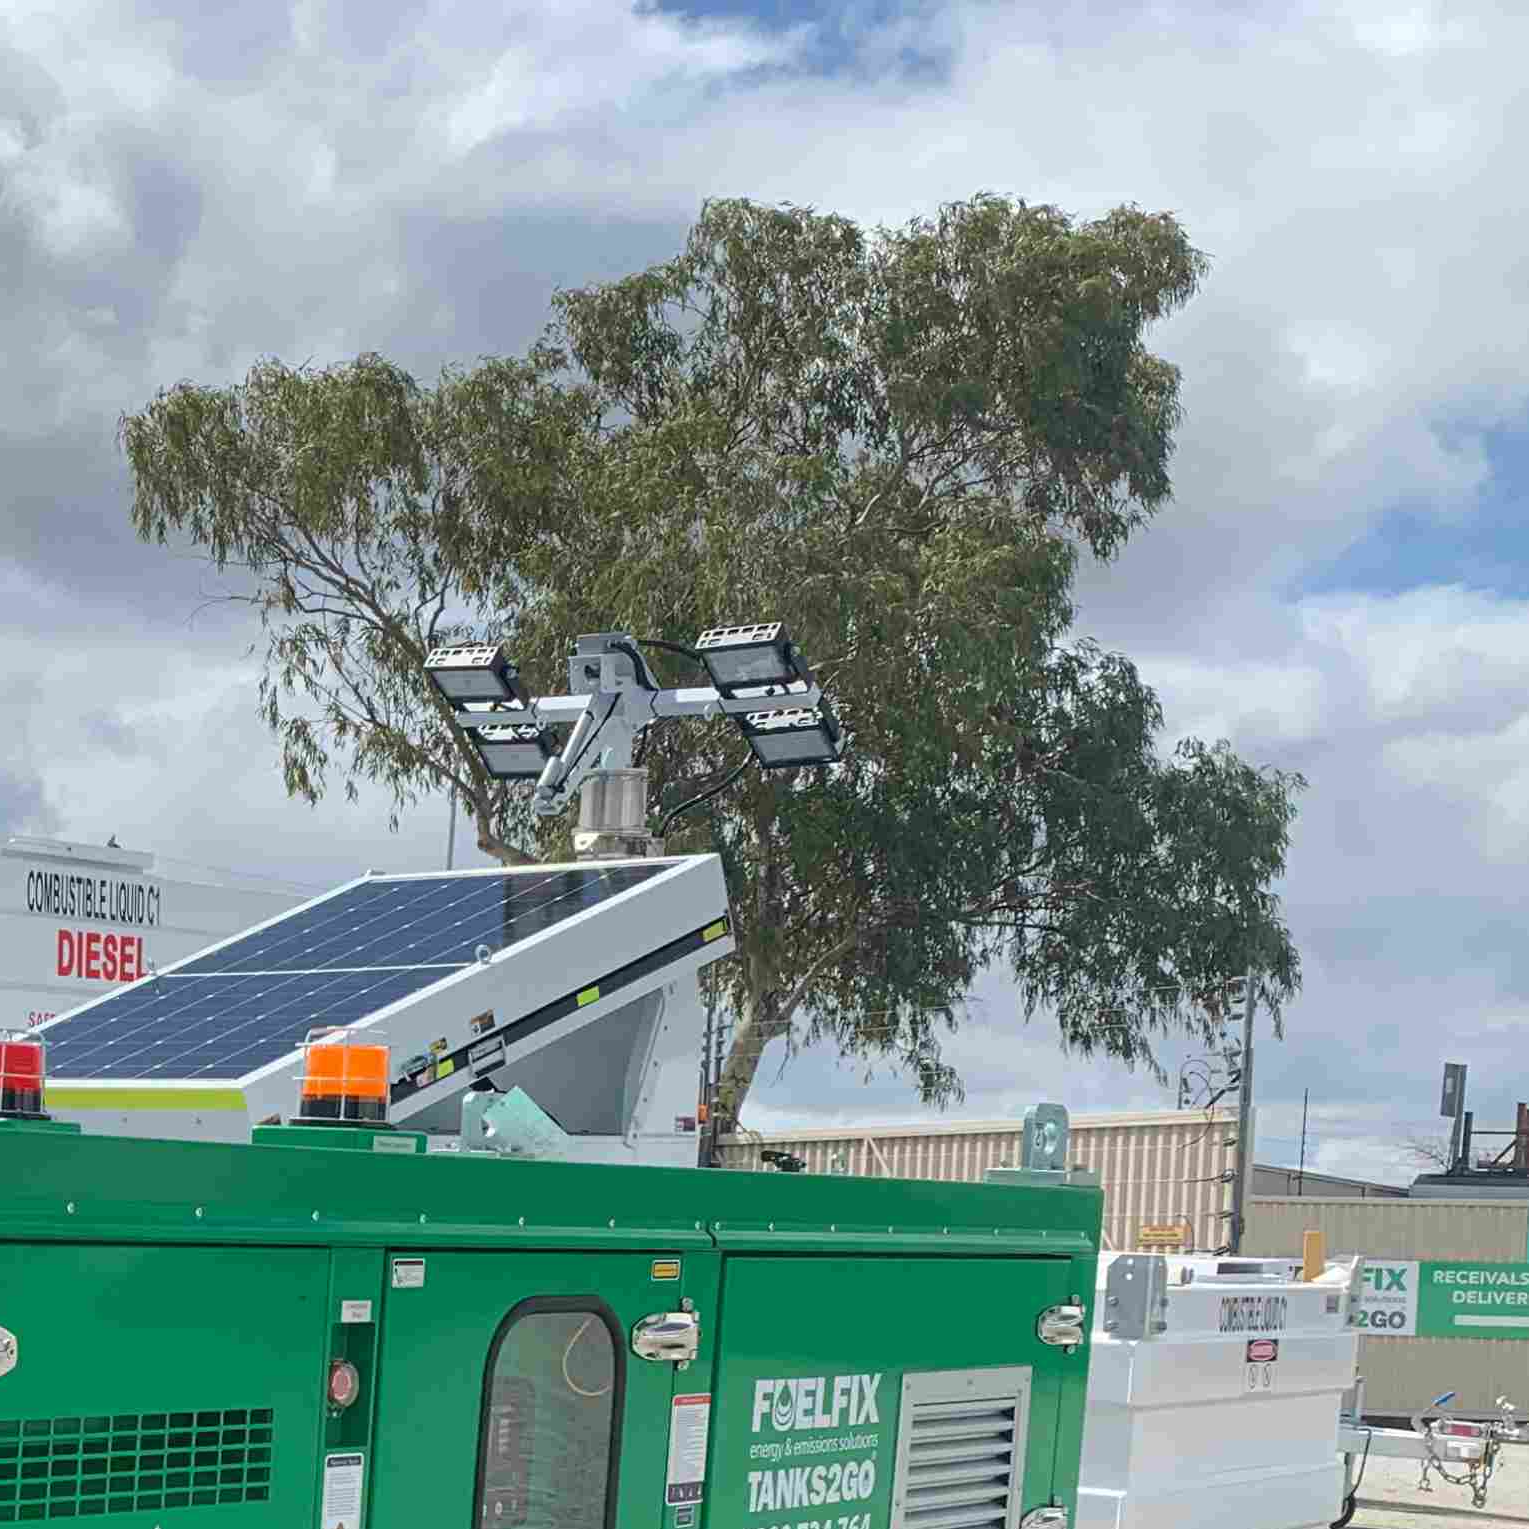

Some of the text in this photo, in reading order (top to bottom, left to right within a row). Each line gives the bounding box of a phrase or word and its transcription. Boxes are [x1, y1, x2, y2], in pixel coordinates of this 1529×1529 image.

[27, 870, 161, 926] COMBUSTIBLE LIQUID C1
[57, 930, 150, 983] DIESEL
[1432, 1269, 1529, 1286] RECEIVALS
[1452, 1289, 1529, 1305] DELIVER
[752, 1373, 882, 1432] FUELFIX
[750, 1431, 878, 1462] energy & emissions solutions
